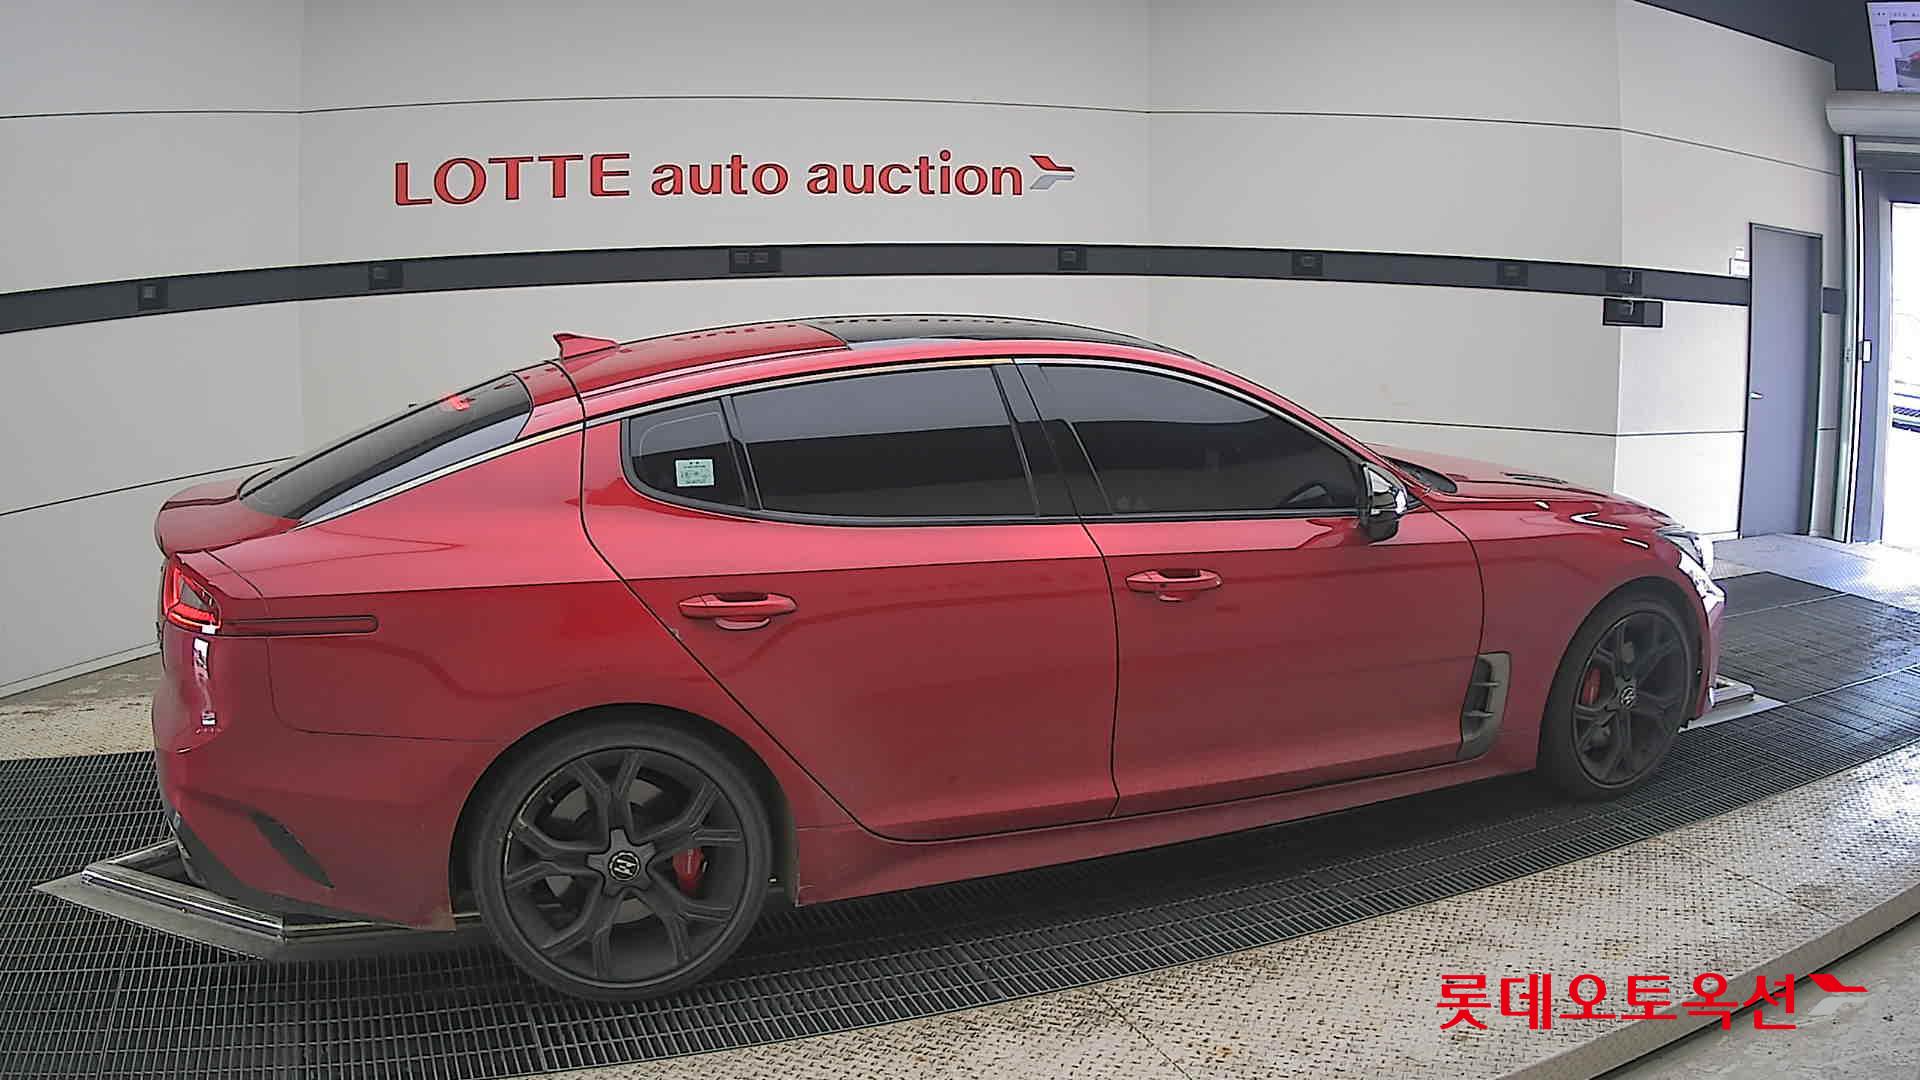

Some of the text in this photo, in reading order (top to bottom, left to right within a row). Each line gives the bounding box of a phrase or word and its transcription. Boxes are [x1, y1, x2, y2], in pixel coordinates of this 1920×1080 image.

[394, 150, 1023, 206] LOTTE auto auction
